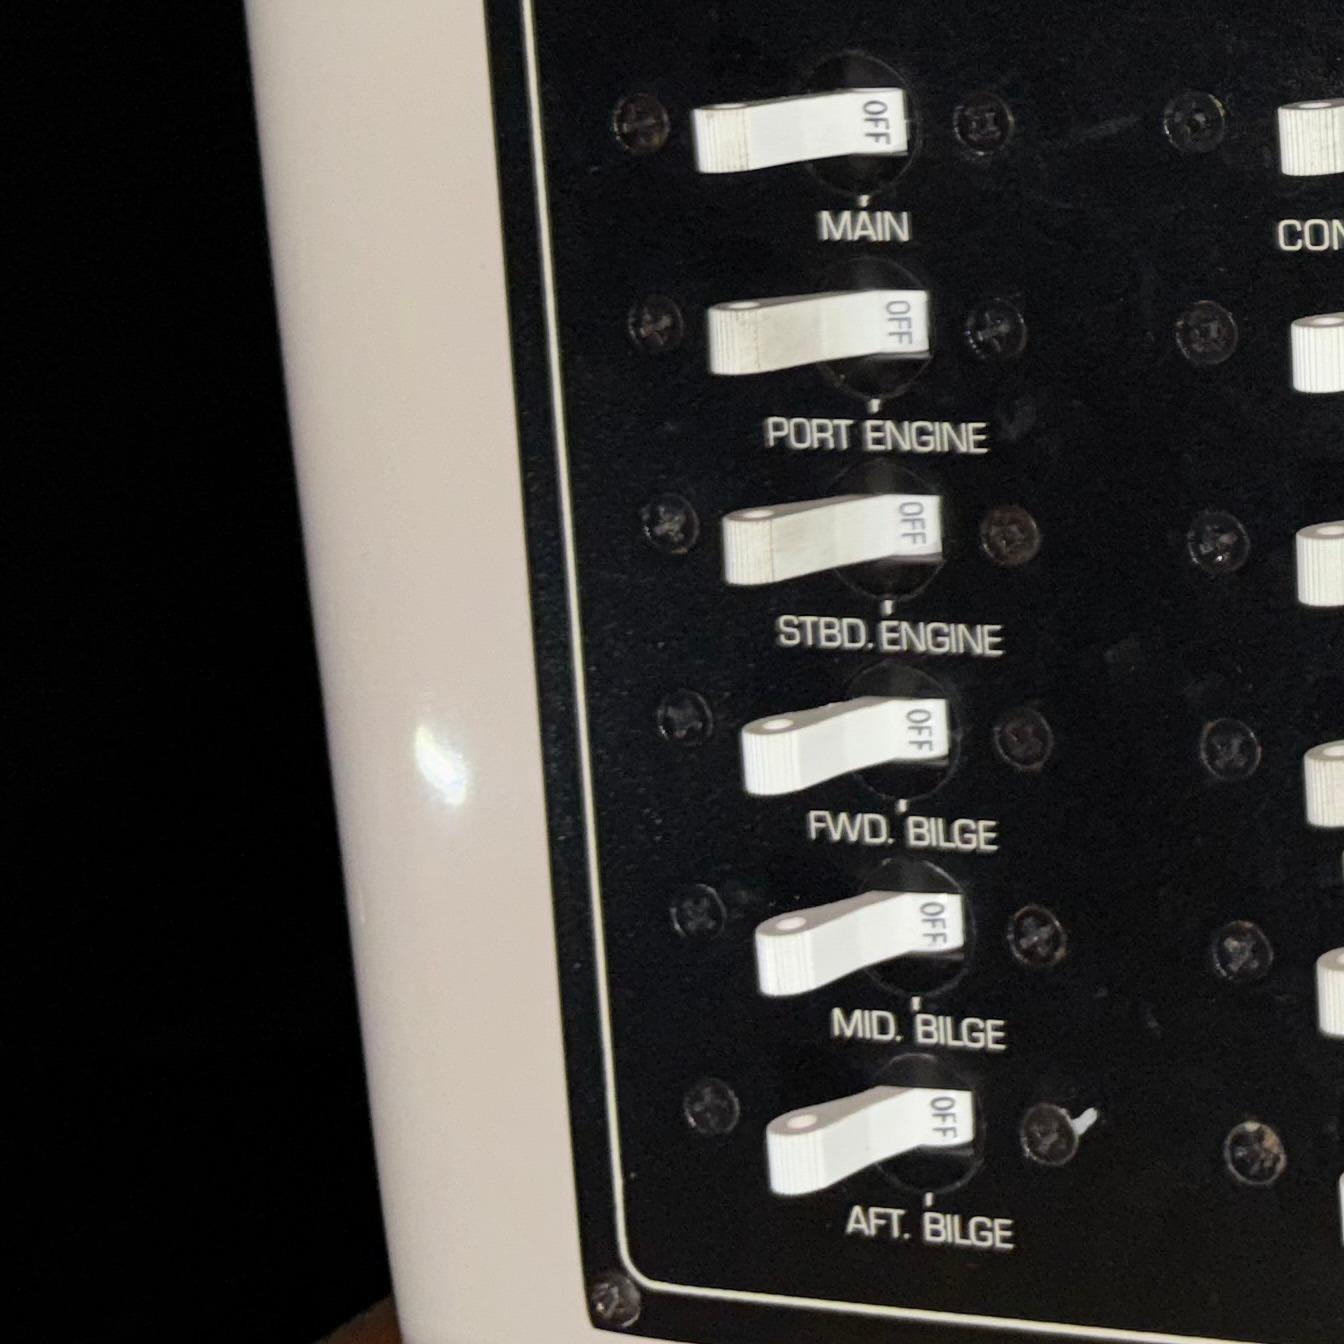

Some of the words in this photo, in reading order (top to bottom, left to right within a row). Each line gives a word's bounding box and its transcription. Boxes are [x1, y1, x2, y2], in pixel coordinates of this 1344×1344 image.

[862, 99, 891, 145] OFF
[817, 211, 911, 243] MAIN
[885, 300, 912, 346] OFF
[765, 416, 853, 450] PORT
[864, 421, 990, 455] ENGINE
[899, 501, 927, 546] OFF
[777, 614, 873, 650] STBD.
[879, 620, 1005, 656] ENGINE
[906, 708, 933, 752] OFF
[807, 809, 894, 845] FWD.
[906, 815, 998, 851] BILGE
[920, 901, 947, 945] OFF
[831, 1007, 904, 1042] MID.
[915, 1013, 1007, 1050] BILGE
[930, 1096, 957, 1139] OFF
[845, 1205, 910, 1240] AFT.
[923, 1211, 1014, 1249] BILGE
